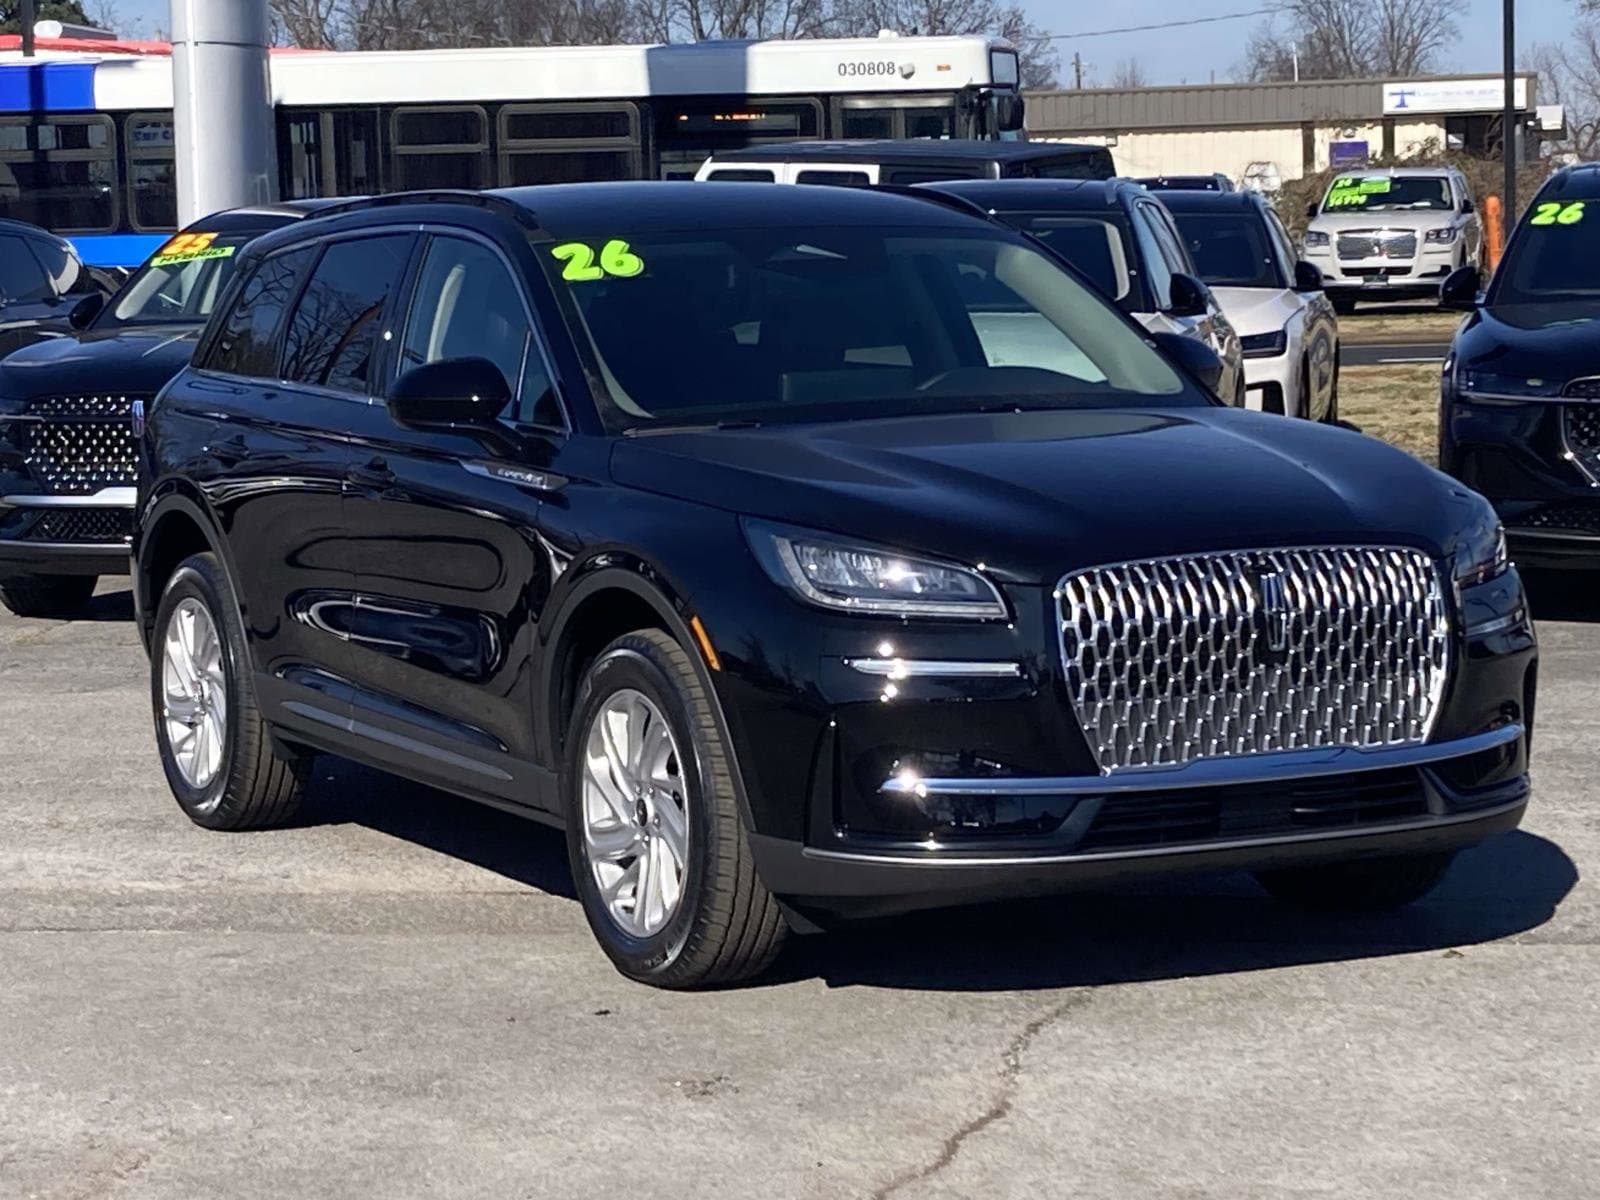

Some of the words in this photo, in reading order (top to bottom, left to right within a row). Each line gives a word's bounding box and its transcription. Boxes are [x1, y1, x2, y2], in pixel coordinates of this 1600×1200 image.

[838, 61, 895, 76] 030808
[1530, 202, 1585, 225] 26
[161, 232, 219, 255] 25
[551, 239, 645, 281] 26
